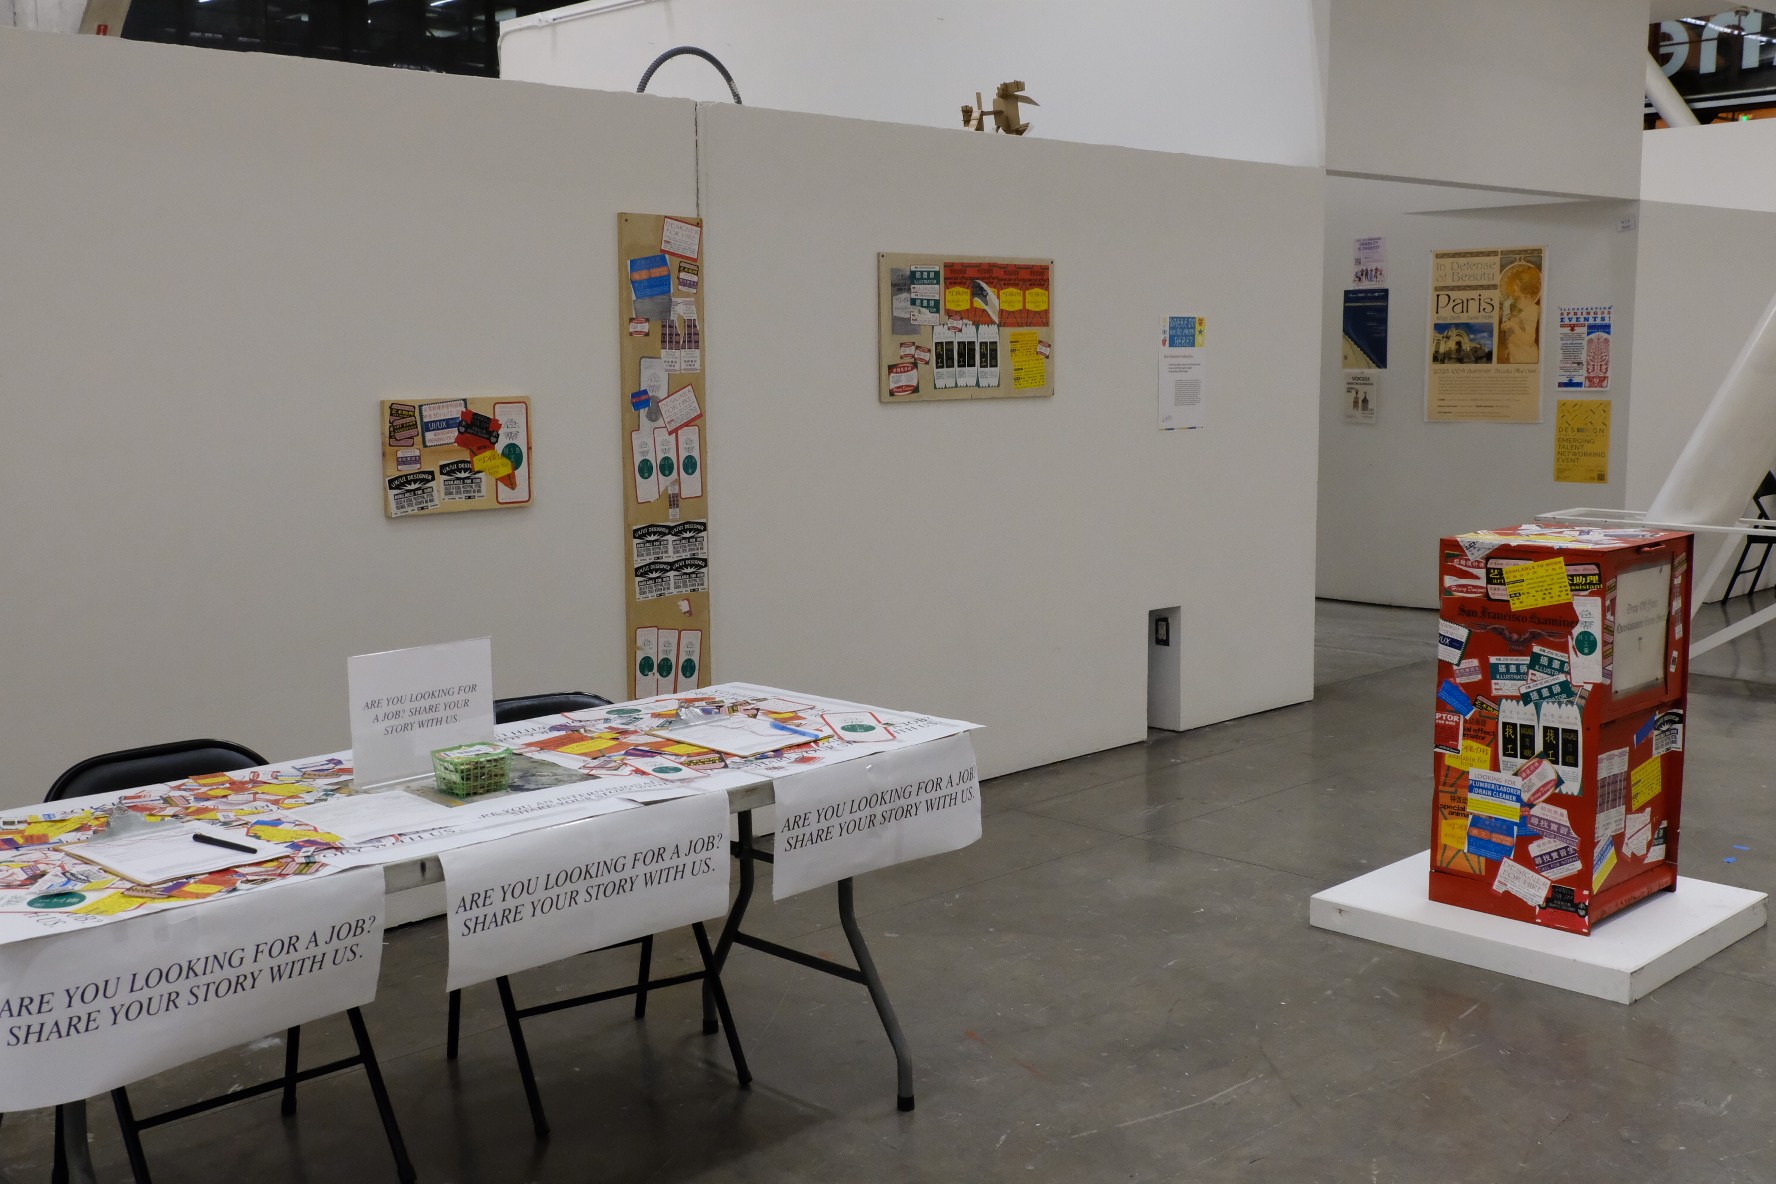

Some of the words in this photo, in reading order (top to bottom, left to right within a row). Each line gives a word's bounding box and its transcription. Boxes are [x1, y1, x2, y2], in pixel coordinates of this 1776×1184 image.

[1451, 261, 1497, 271] Defense
[1435, 293, 1495, 315] Paris
[428, 422, 447, 431] UI/UX
[407, 472, 433, 481] DESIGNER
[1458, 604, 1478, 617] San
[1481, 605, 1528, 622] Francisco
[1530, 611, 1577, 628] Examine
[363, 698, 384, 711] ARE
[385, 694, 407, 707] YOU
[409, 687, 455, 703] LOOKING
[457, 683, 478, 695] FOR
[372, 713, 380, 724] A
[381, 709, 406, 722] JOB?
[408, 703, 441, 718] SHARE
[443, 698, 470, 712] YOUR
[383, 721, 416, 736] STORY
[418, 716, 443, 730] WITH
[445, 714, 461, 725] US.
[1473, 727, 1496, 737] effect
[1469, 780, 1521, 796] PLUMBER/LABORER
[1474, 773, 1502, 783] LOOKING
[1504, 778, 1516, 786] FOR
[781, 811, 812, 833] ARE
[816, 801, 846, 824] YOU
[849, 784, 913, 814] LOOKING
[916, 776, 943, 797] FOR
[945, 774, 953, 788] A
[1439, 803, 1466, 812] special
[1493, 791, 1517, 802] CLEANER
[784, 825, 835, 852] SHARE
[838, 814, 876, 838] YOUR
[879, 801, 922, 825] STORY
[925, 792, 958, 813] WITH
[960, 786, 975, 804] US.
[1449, 810, 1470, 818] anima
[455, 888, 495, 914] ARE
[500, 876, 540, 903] YOU
[543, 855, 627, 891] LOOKING
[631, 846, 666, 870] FOR
[669, 843, 681, 860] A
[684, 833, 723, 857] JOB?
[1503, 861, 1548, 887] DESIGNER
[1537, 864, 1550, 872] CALL
[1550, 861, 1560, 869] FOR
[1502, 869, 1521, 882] FOR
[1523, 880, 1542, 892] HIRE
[461, 904, 525, 937] SHARE
[530, 889, 579, 918] YOUR
[584, 874, 639, 903] STORY
[644, 863, 687, 888] WITH
[691, 857, 715, 877] US.
[0, 992, 54, 1019] ARE
[64, 976, 122, 1009] YOU
[129, 947, 246, 993] LOOKING
[252, 934, 300, 964] FOR
[305, 930, 320, 950] A
[324, 915, 377, 945] JOB?
[7, 1010, 101, 1046] SHARE
[110, 990, 180, 1027] YOUR
[187, 968, 263, 1006] STORY
[269, 952, 327, 984] WITH
[331, 943, 364, 967] US.
